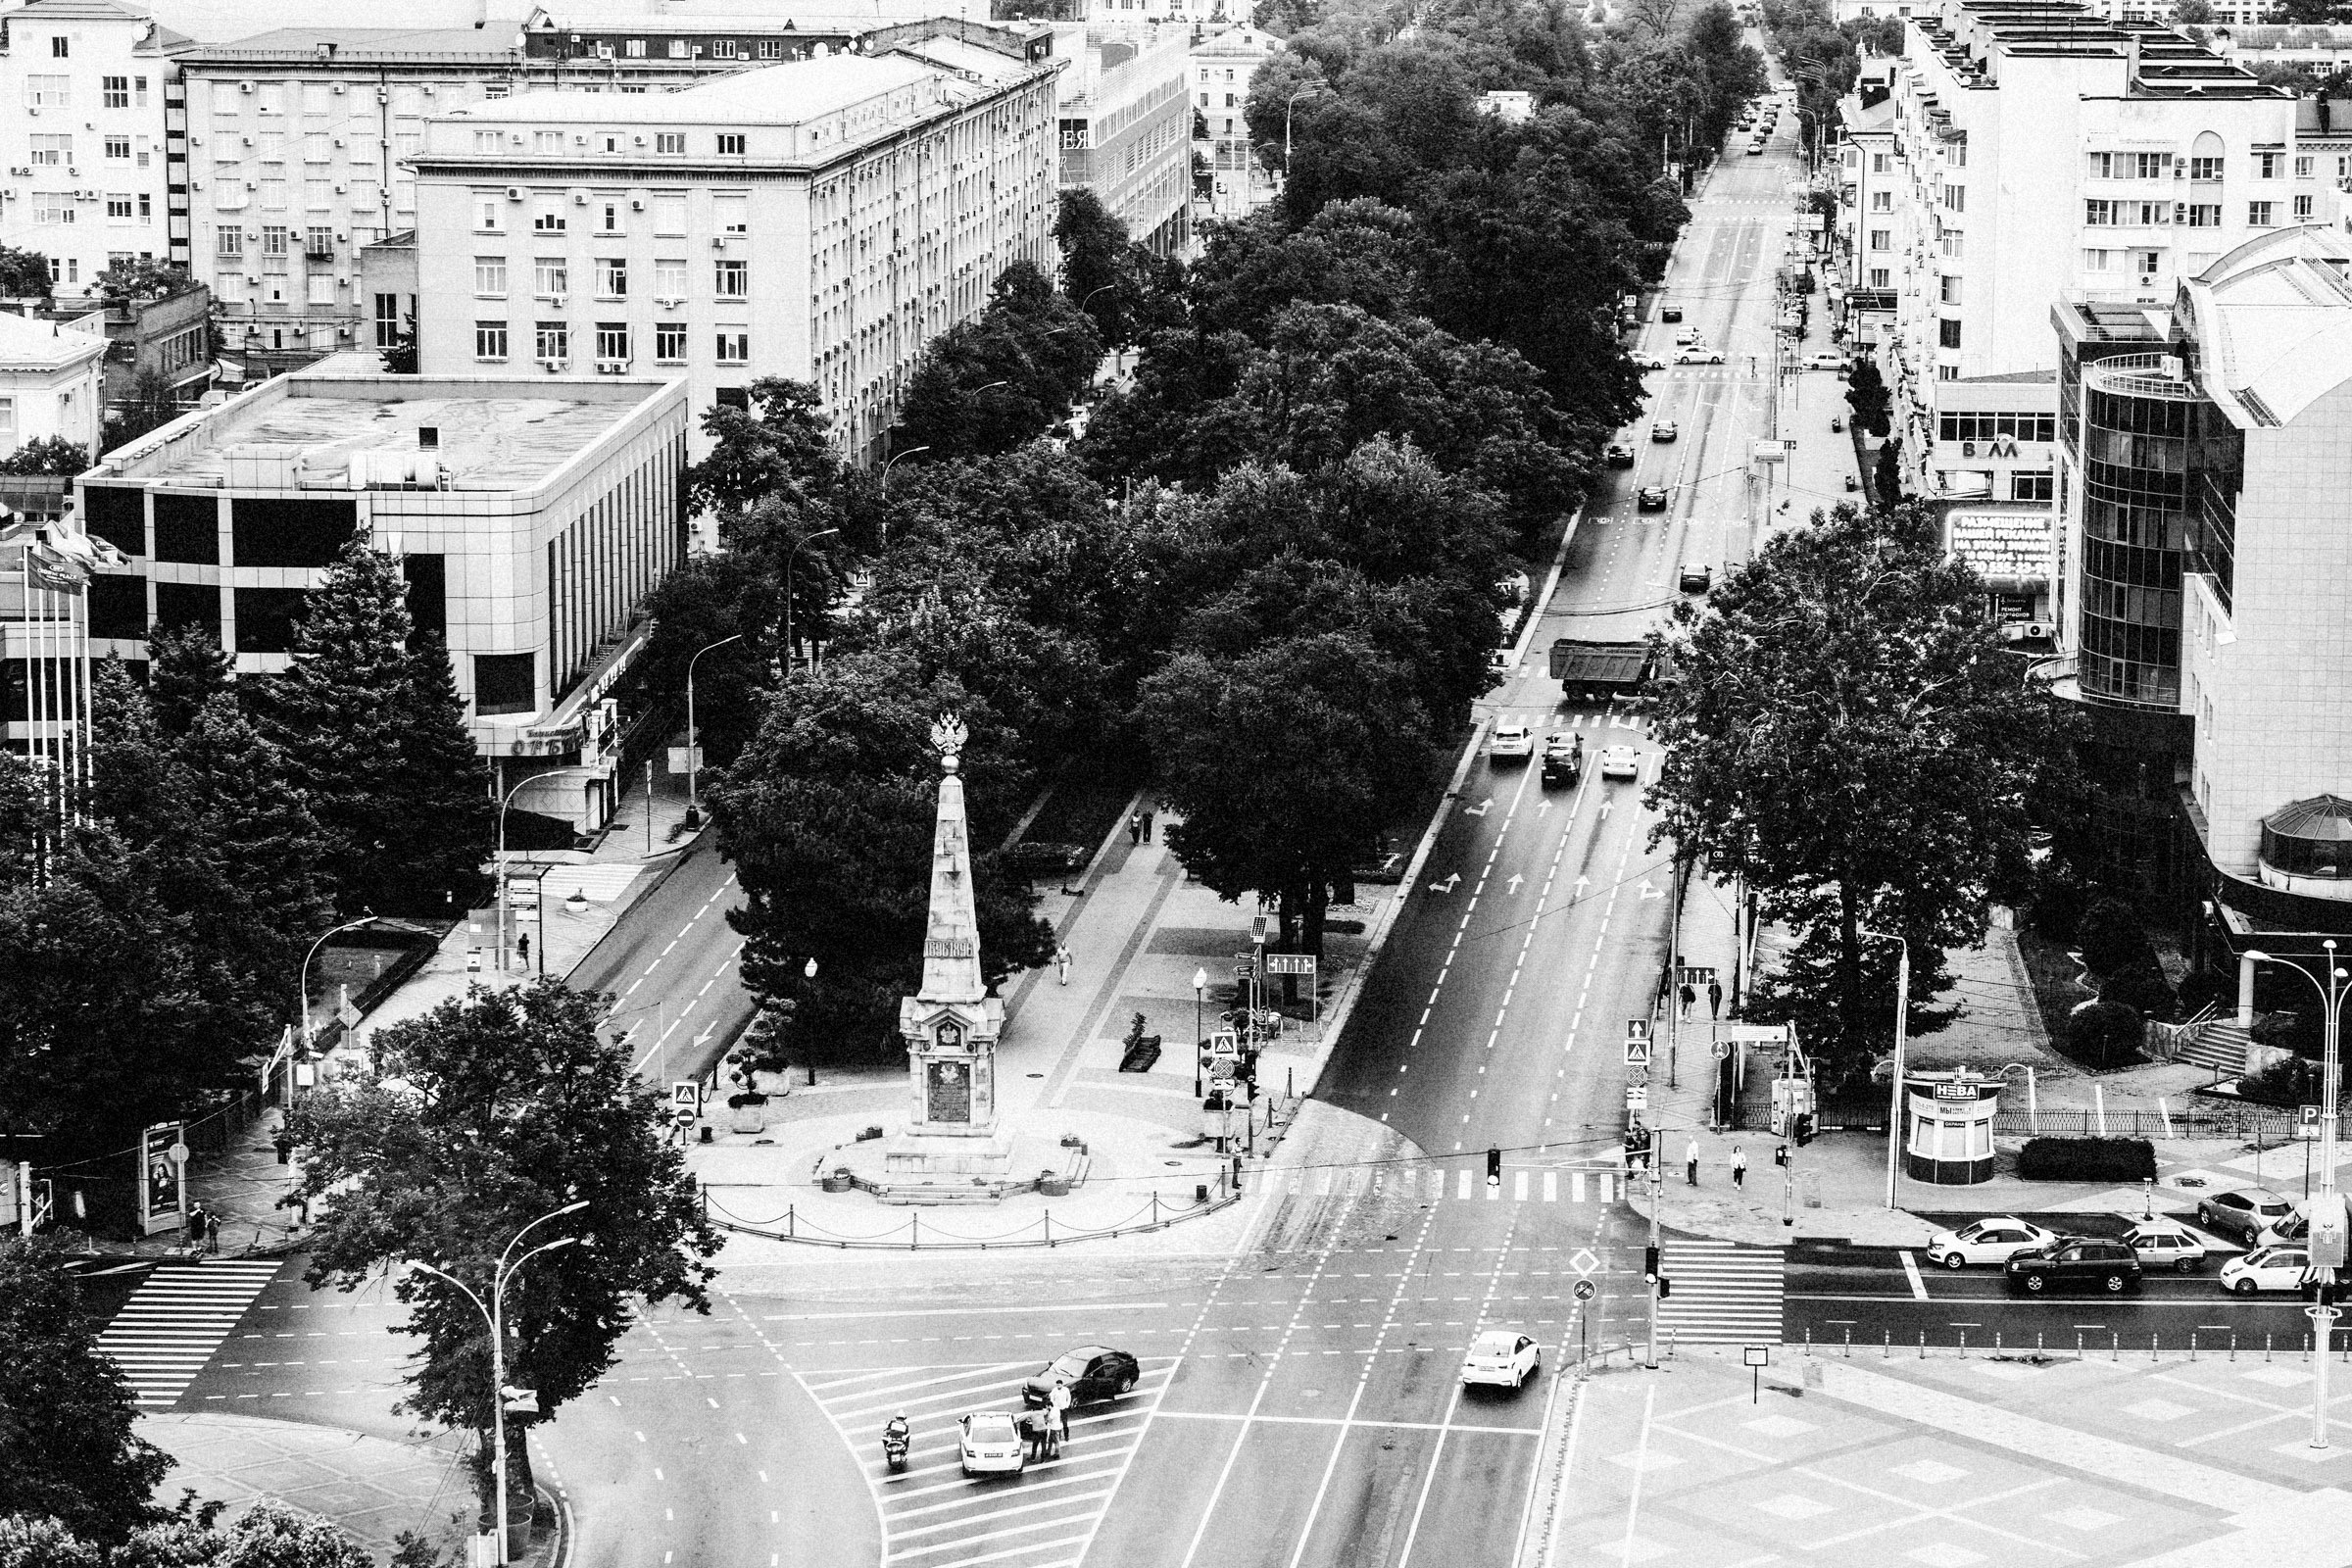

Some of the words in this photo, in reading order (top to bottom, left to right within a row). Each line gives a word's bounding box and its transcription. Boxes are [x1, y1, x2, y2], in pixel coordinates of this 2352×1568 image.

[1961, 516, 2045, 529] РАЗМЕЩЕНИЕ
[1953, 527, 1993, 539] ВАШЕЙ
[1954, 539, 1971, 550] НА
[1973, 540, 2005, 551] ЭТОМ
[2007, 541, 2050, 551] ЭКРАНЕ
[2305, 1108, 2317, 1123] P
